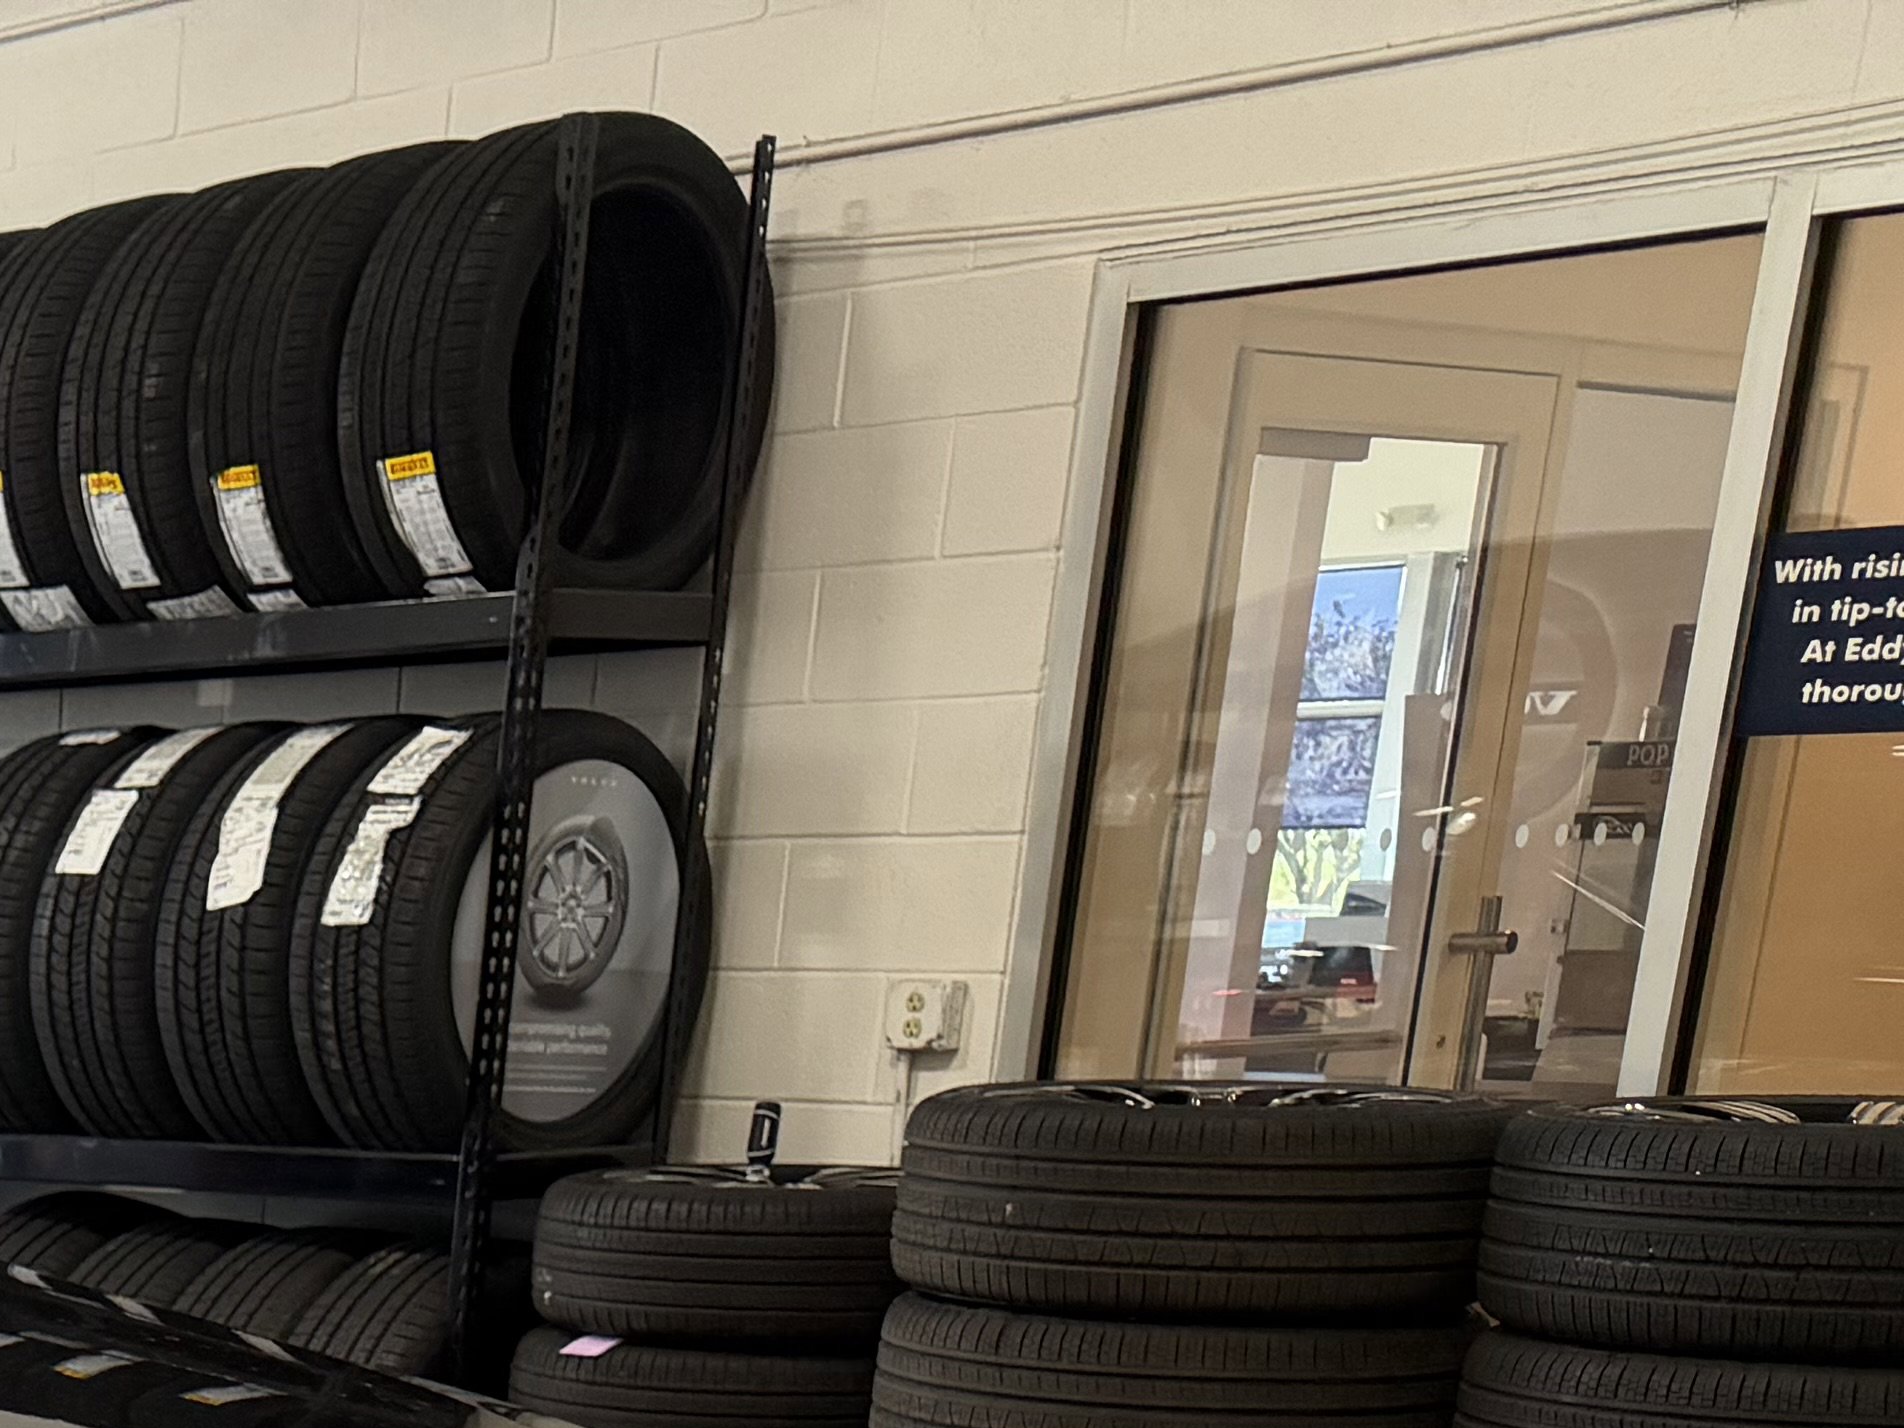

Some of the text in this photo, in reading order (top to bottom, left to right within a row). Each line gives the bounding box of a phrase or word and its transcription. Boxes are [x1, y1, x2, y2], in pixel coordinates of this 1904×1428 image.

[1775, 555, 1843, 584] With
[1791, 598, 1822, 624] in
[1800, 634, 1904, 666] At Edd
[1801, 678, 1904, 706] thorou
